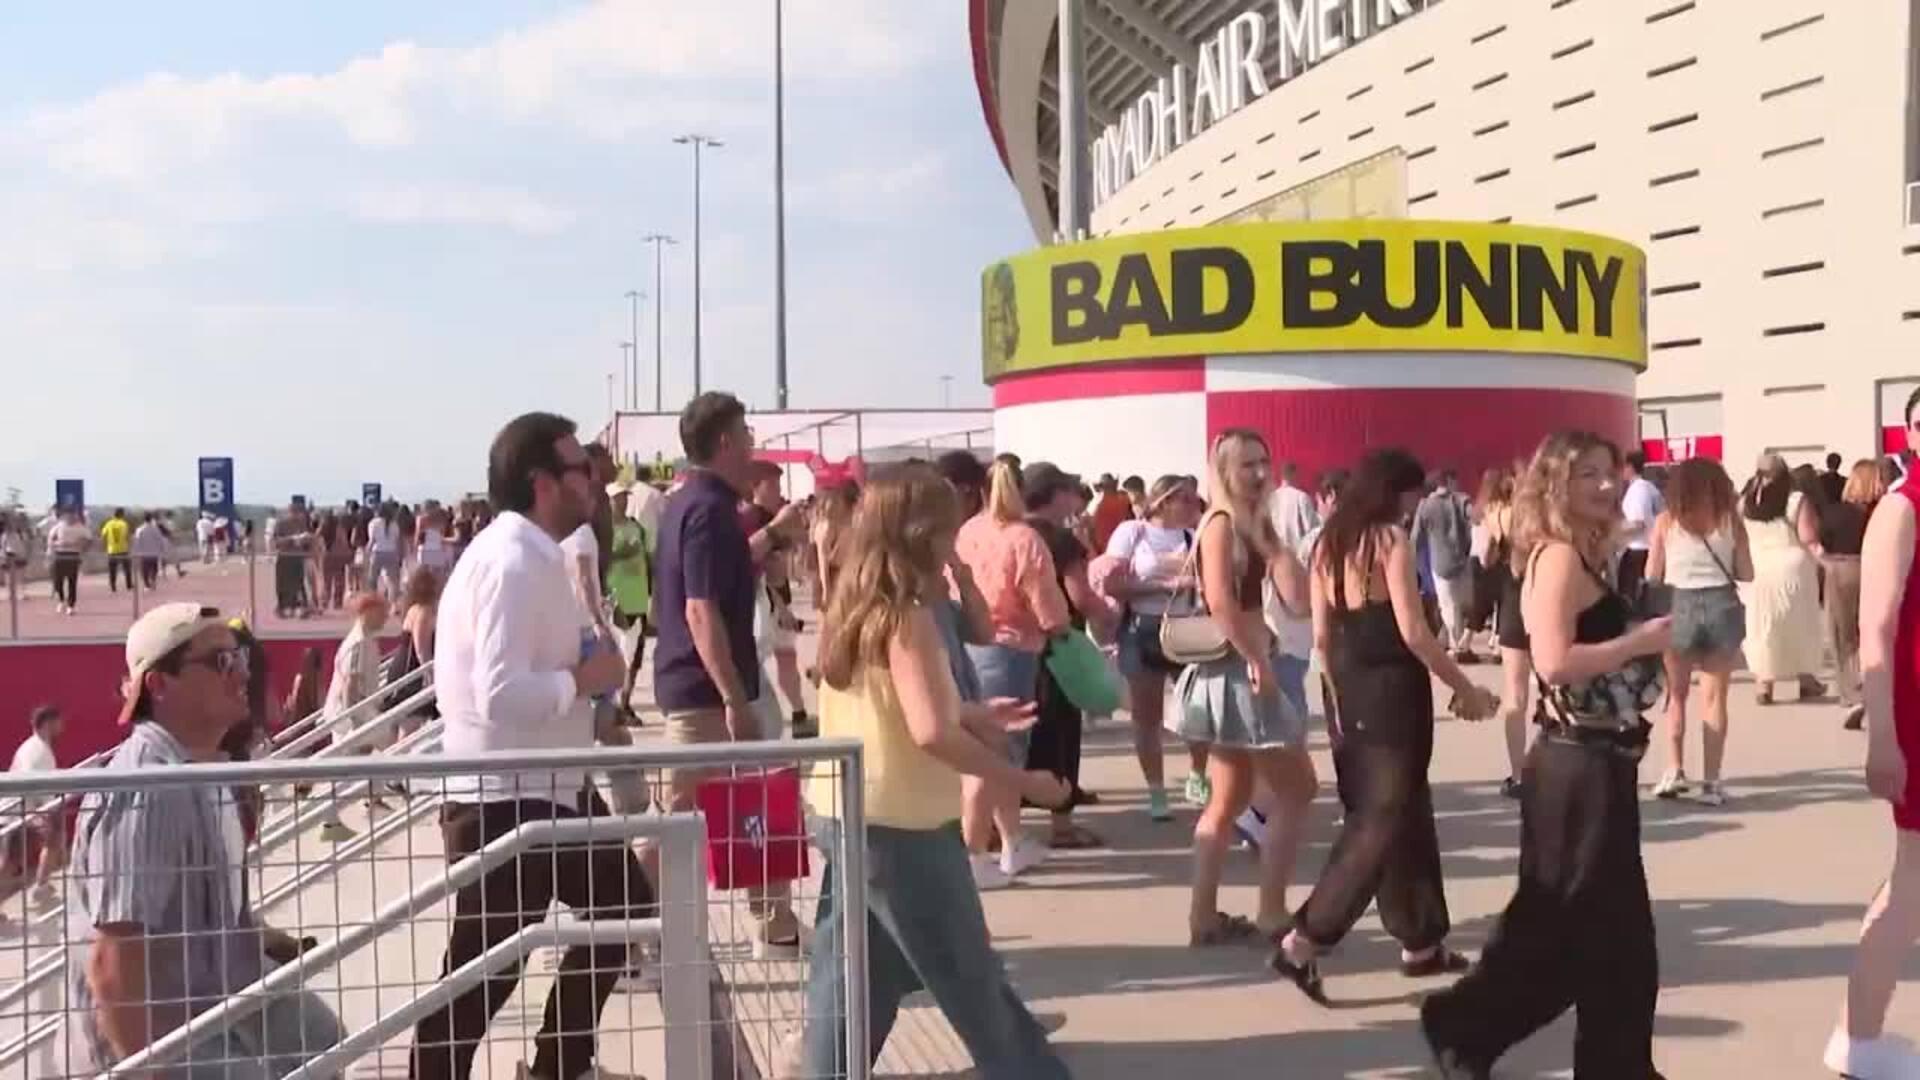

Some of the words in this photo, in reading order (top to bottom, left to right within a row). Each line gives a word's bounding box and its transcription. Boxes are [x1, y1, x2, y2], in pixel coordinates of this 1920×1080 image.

[1092, 63, 1187, 208] RIYADH
[1191, 11, 1269, 136] AIR
[1278, 0, 1415, 79] ME
[1051, 246, 1255, 345] BAD
[1282, 239, 1624, 337] BUNNY
[203, 478, 225, 504] B
